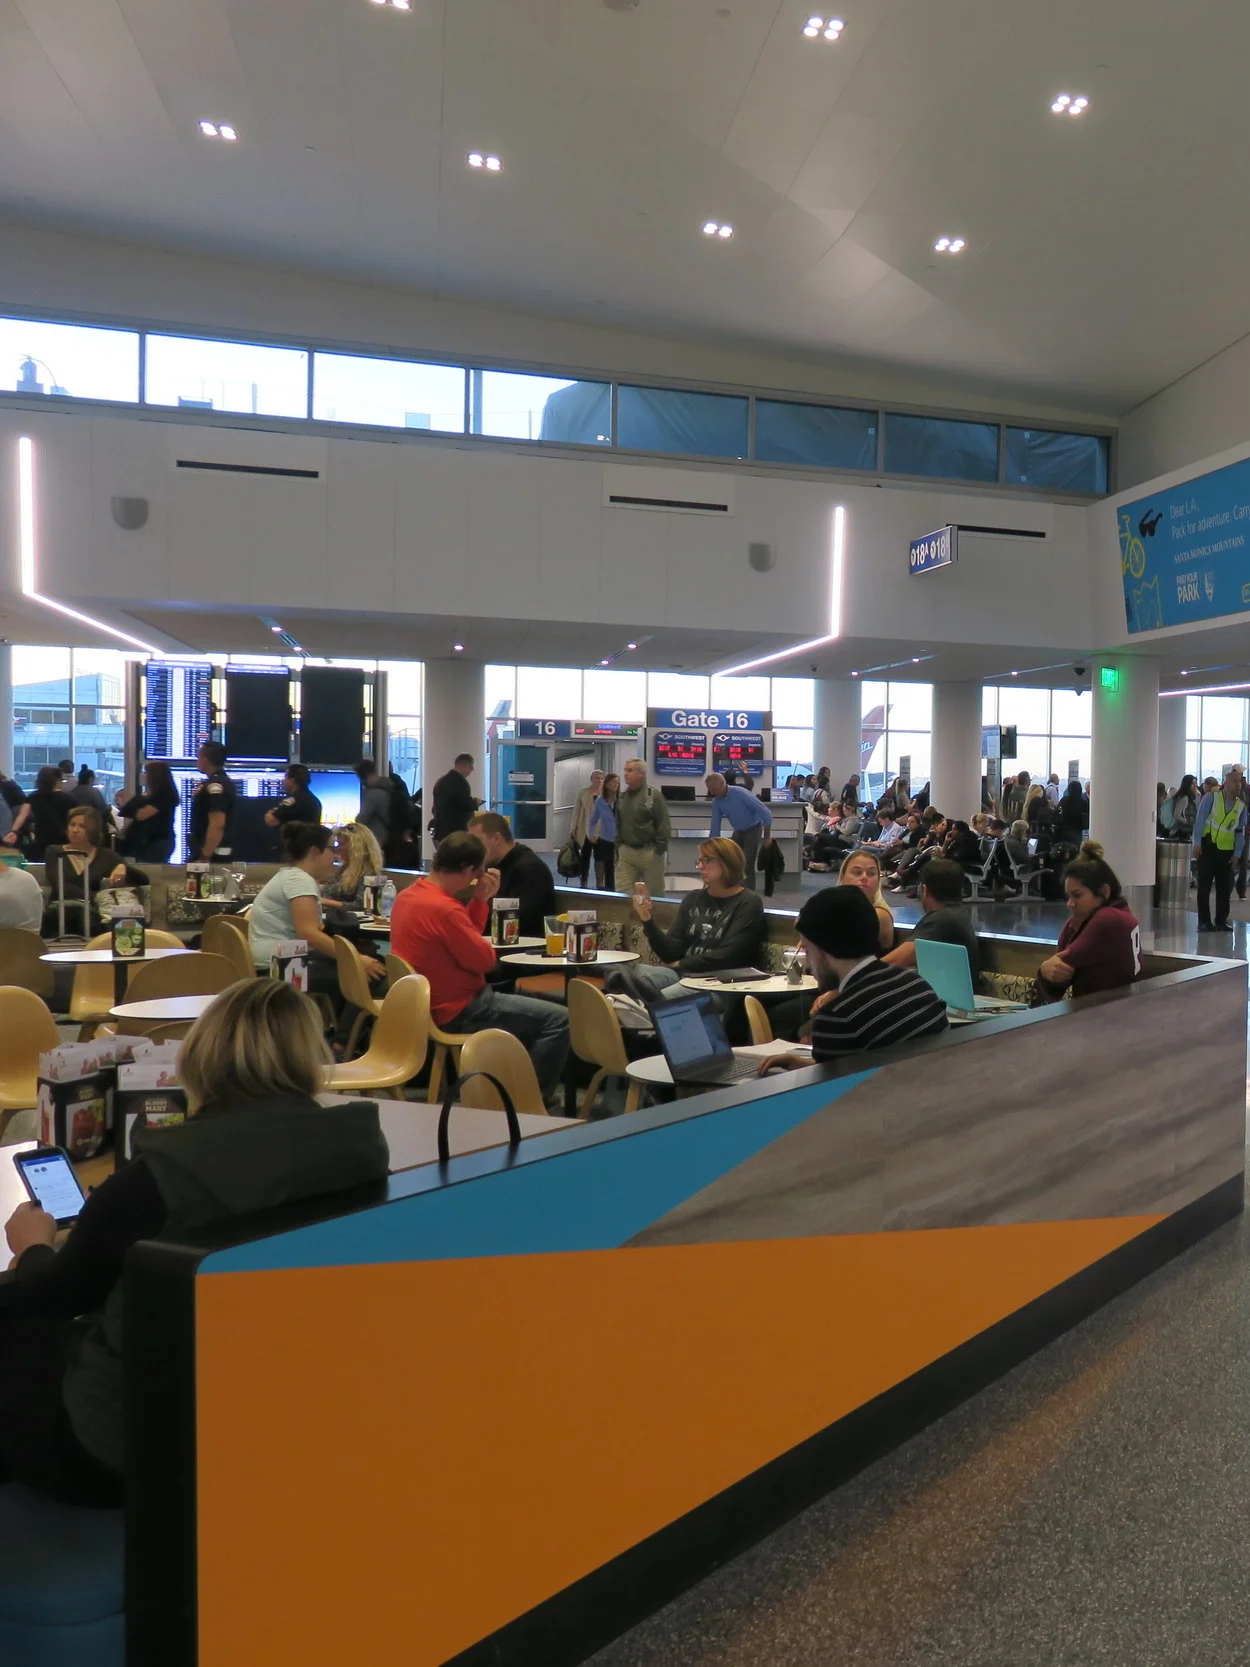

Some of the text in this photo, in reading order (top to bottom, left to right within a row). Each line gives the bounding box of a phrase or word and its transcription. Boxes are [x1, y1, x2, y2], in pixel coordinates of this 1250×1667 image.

[1170, 504, 1185, 519] Dear
[1171, 522, 1187, 540] Pack
[1187, 520, 1197, 535] for
[1174, 535, 1245, 563] SANTA MONICA MOUNTAINS
[1177, 582, 1200, 604] PARK
[535, 721, 556, 735] 16
[671, 710, 749, 728] Gate 16
